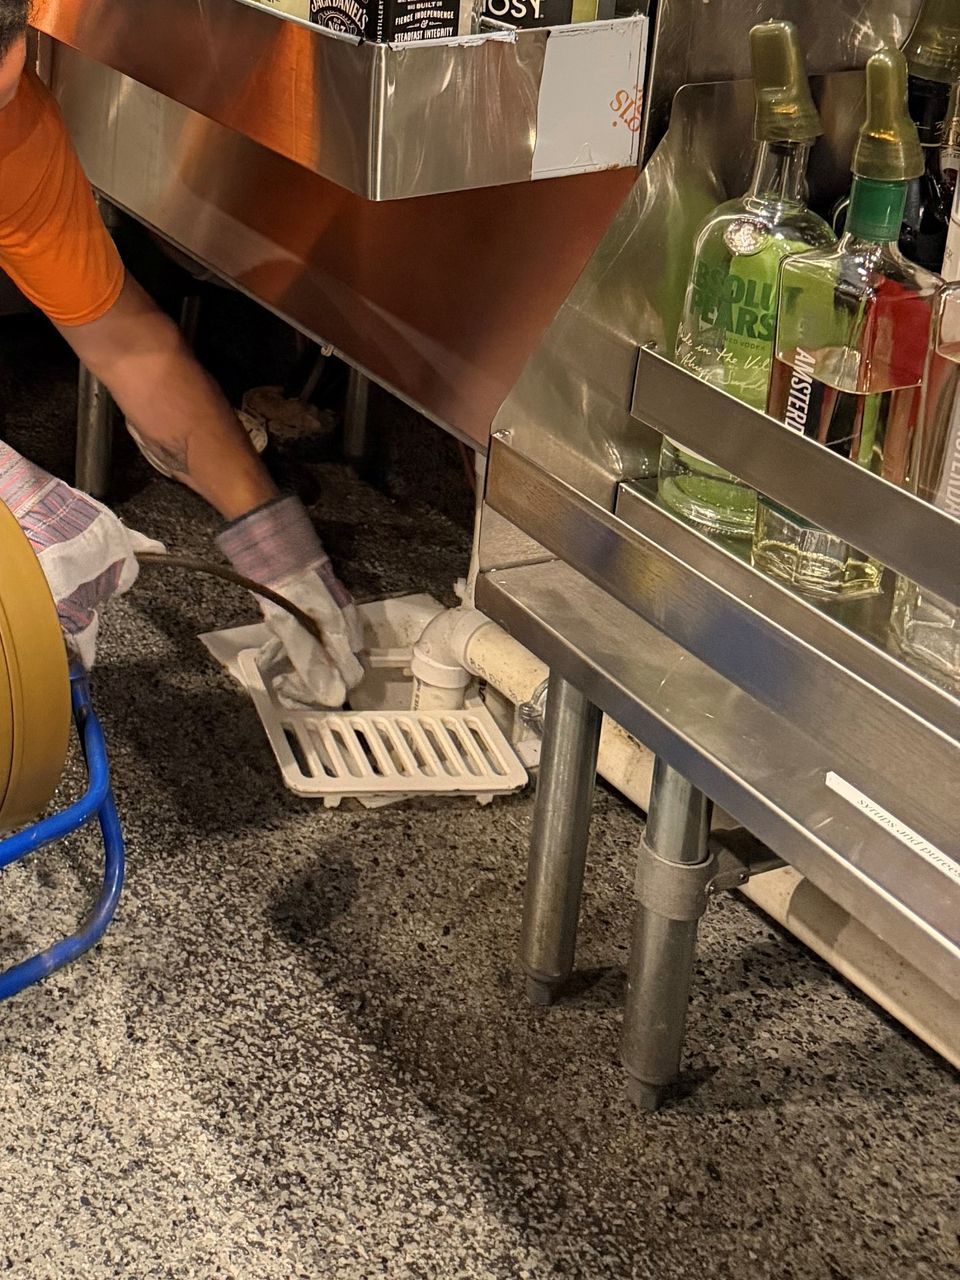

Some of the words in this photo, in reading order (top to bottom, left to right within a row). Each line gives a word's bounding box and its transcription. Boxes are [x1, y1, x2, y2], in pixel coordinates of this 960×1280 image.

[416, 1, 436, 9] BUILT
[376, 0, 385, 43] DISTILLERY
[395, 13, 413, 26] FIERCE
[414, 10, 454, 20] INDEPENDENCE
[394, 30, 423, 43] STEADFAST
[424, 26, 453, 39] INTEGRITY
